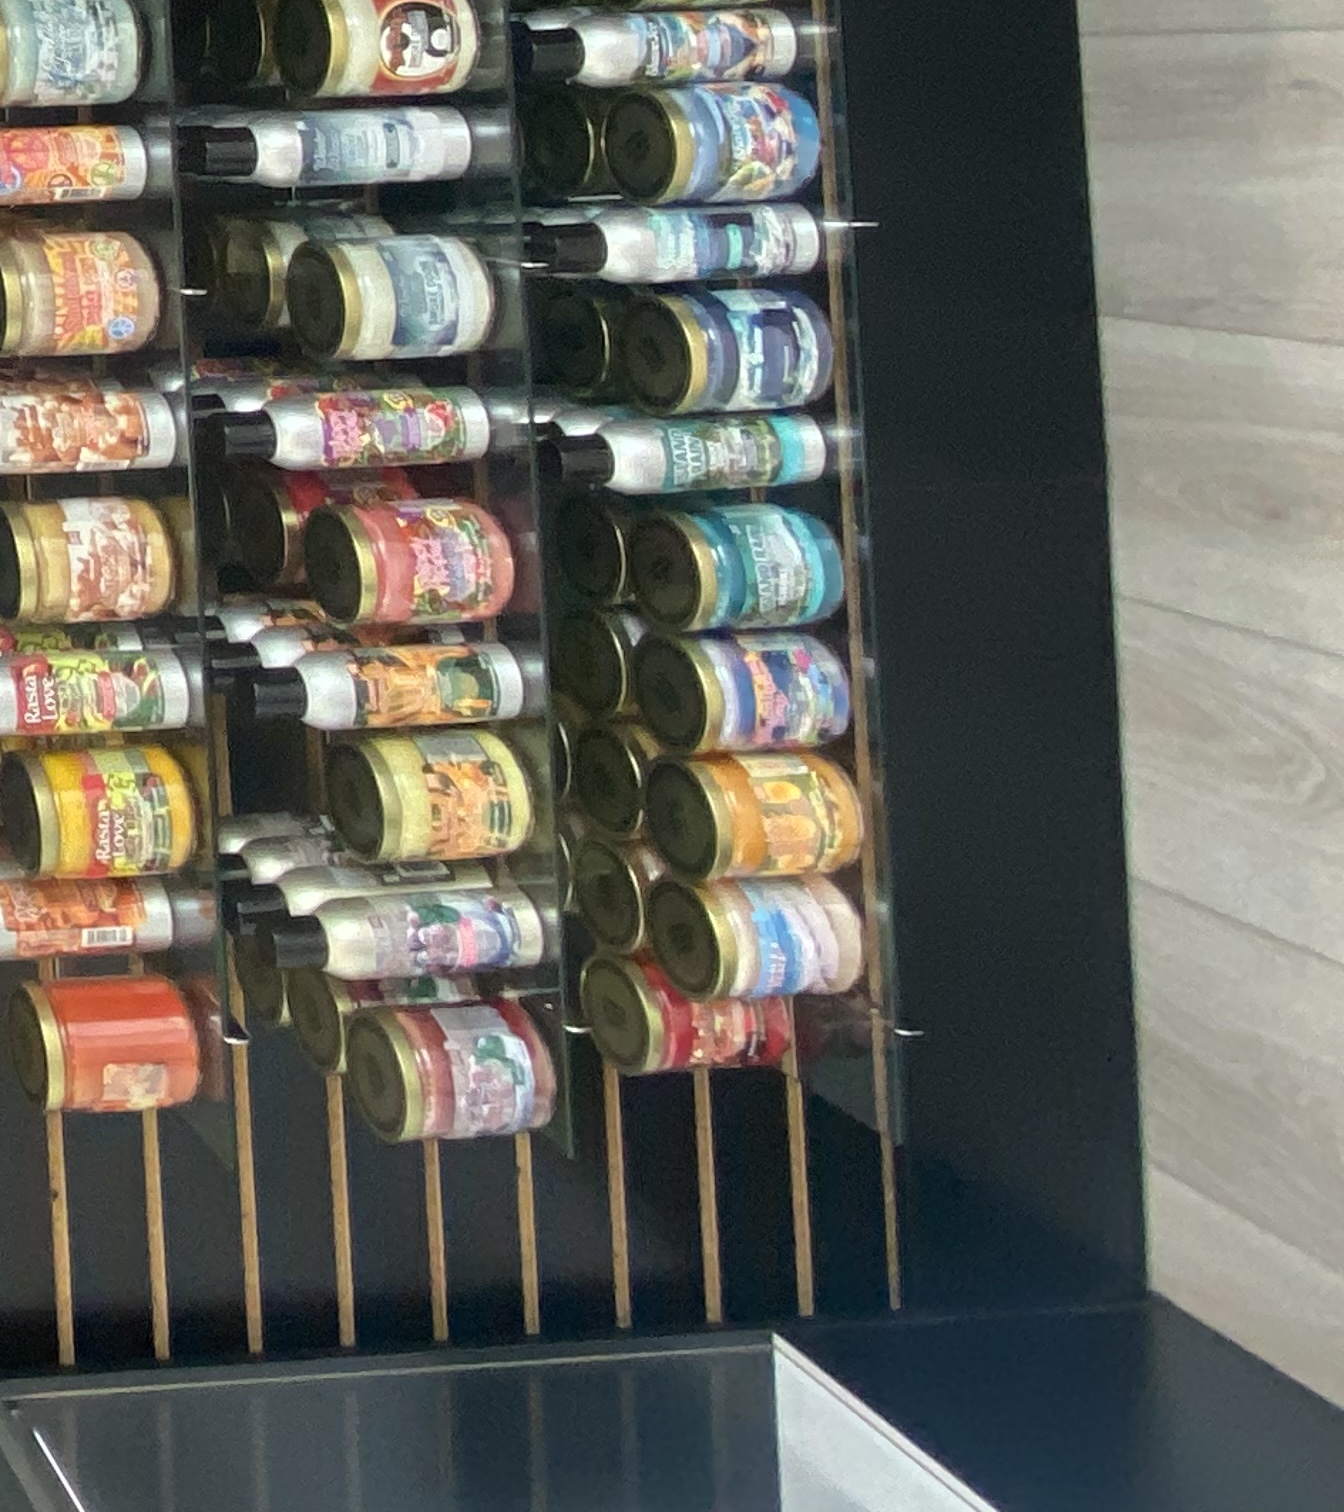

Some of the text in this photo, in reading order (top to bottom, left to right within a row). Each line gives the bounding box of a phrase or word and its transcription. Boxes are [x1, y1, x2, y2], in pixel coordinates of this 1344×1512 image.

[22, 675, 42, 724] Rasta
[41, 675, 59, 721] Love
[94, 810, 111, 860] Rasta
[111, 813, 126, 857] Love
